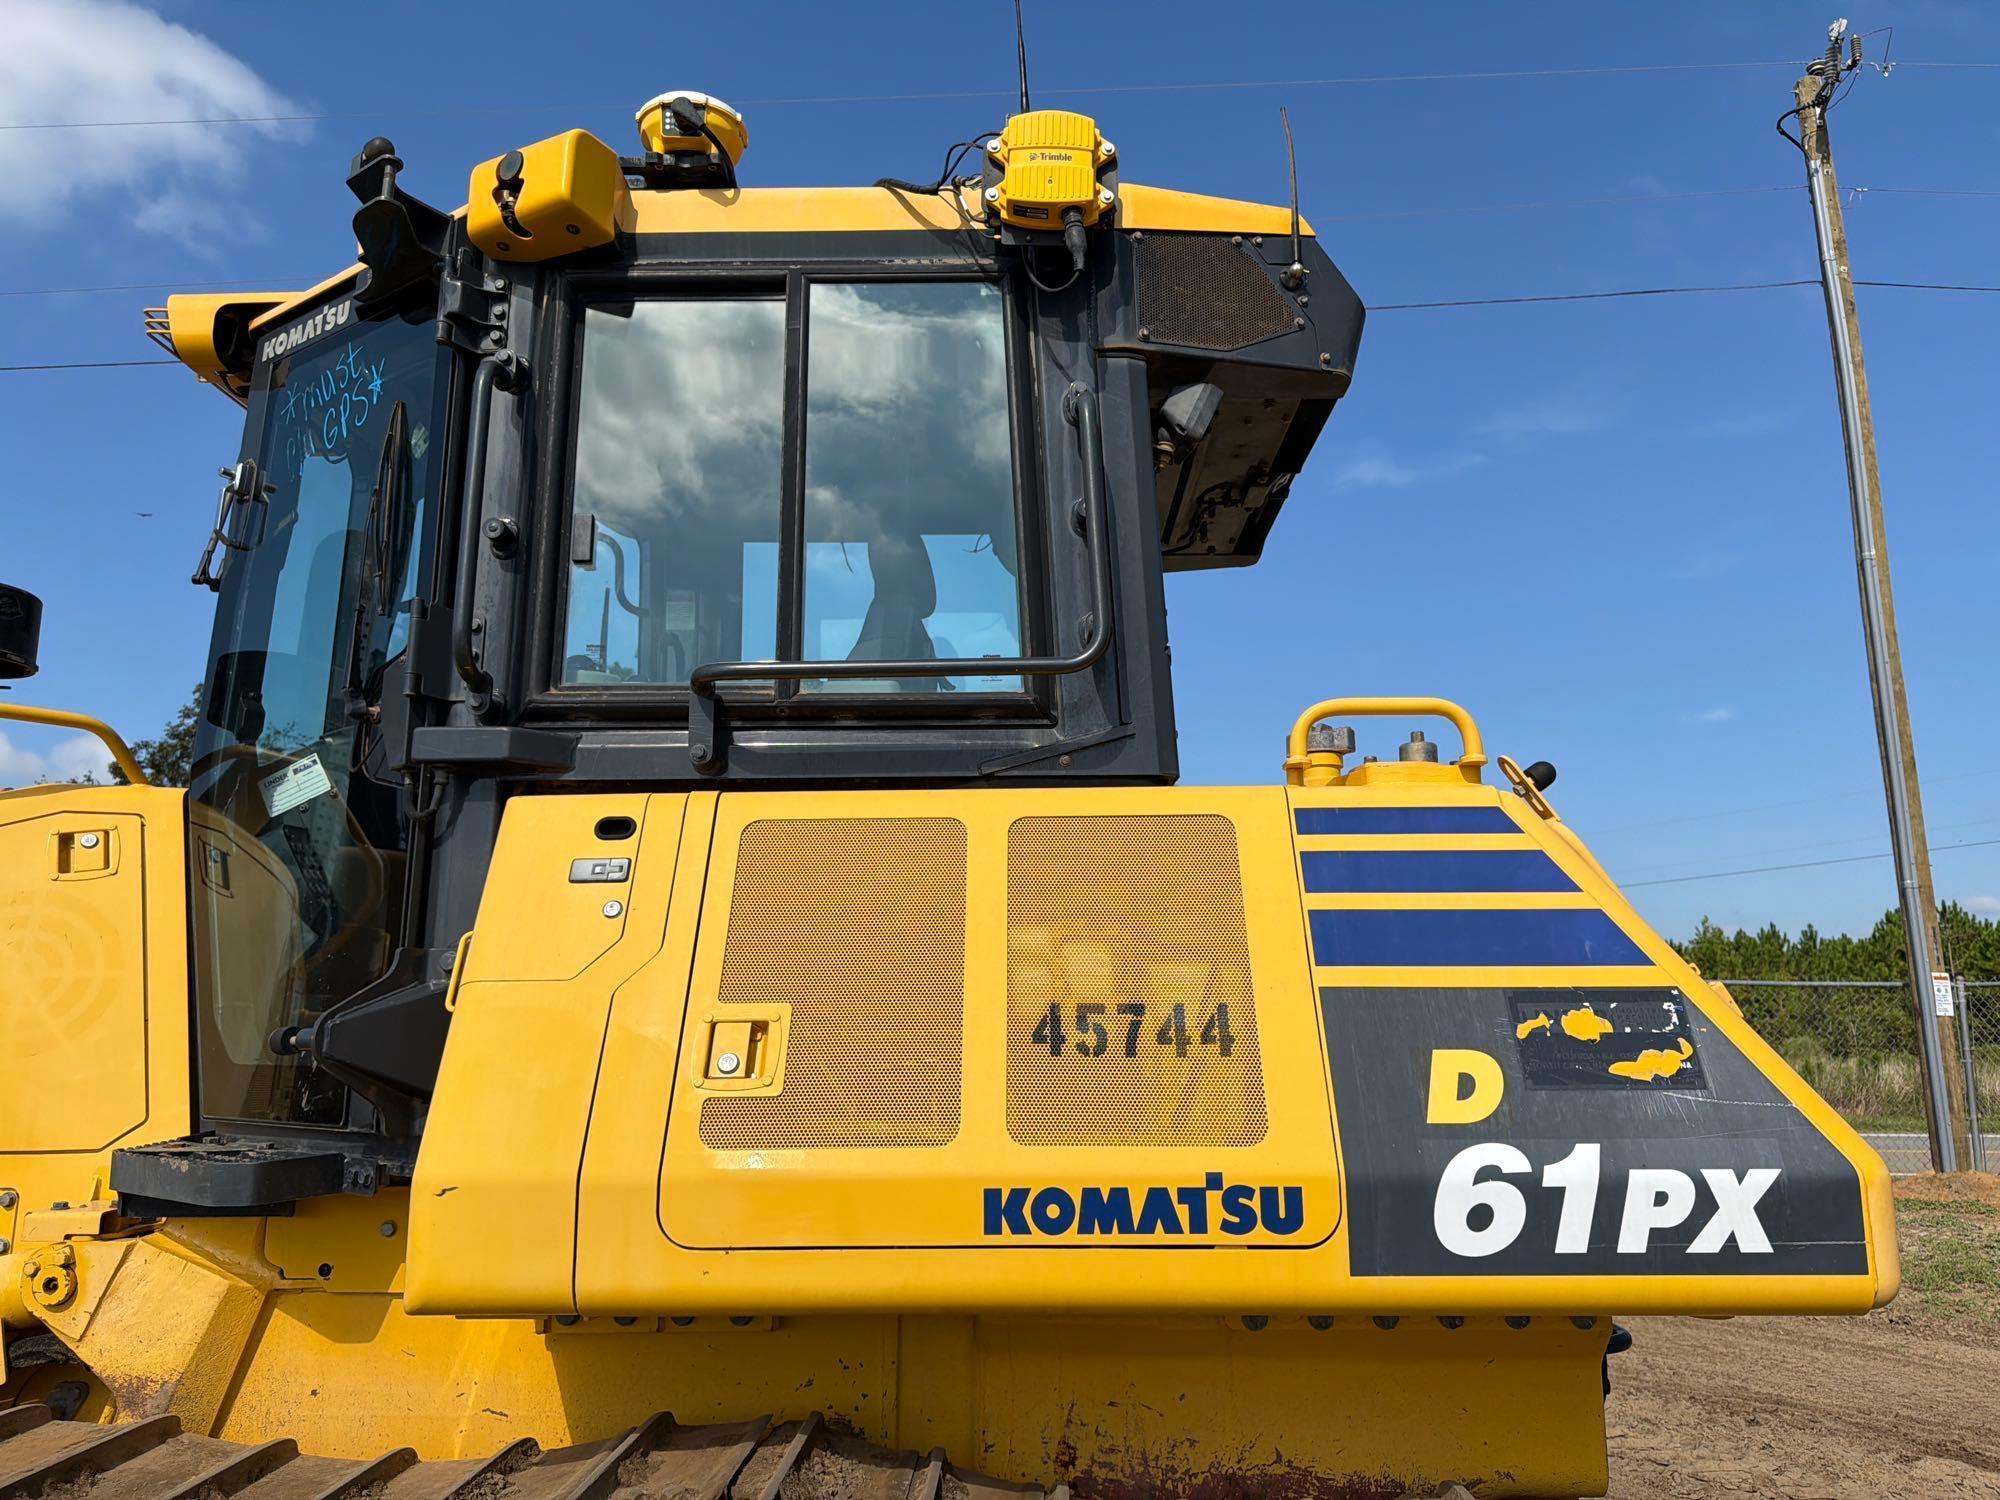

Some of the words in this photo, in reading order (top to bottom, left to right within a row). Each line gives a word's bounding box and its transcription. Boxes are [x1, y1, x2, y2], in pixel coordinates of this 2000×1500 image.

[1040, 153, 1072, 162] Trimble
[261, 300, 351, 362] KOMATSU
[1031, 1002, 1236, 1058] 45744
[1426, 1048, 1504, 1124] D
[983, 1172, 1304, 1236] KOMATSU
[1433, 1142, 1600, 1258] 61
[1616, 1168, 1782, 1254] PX
